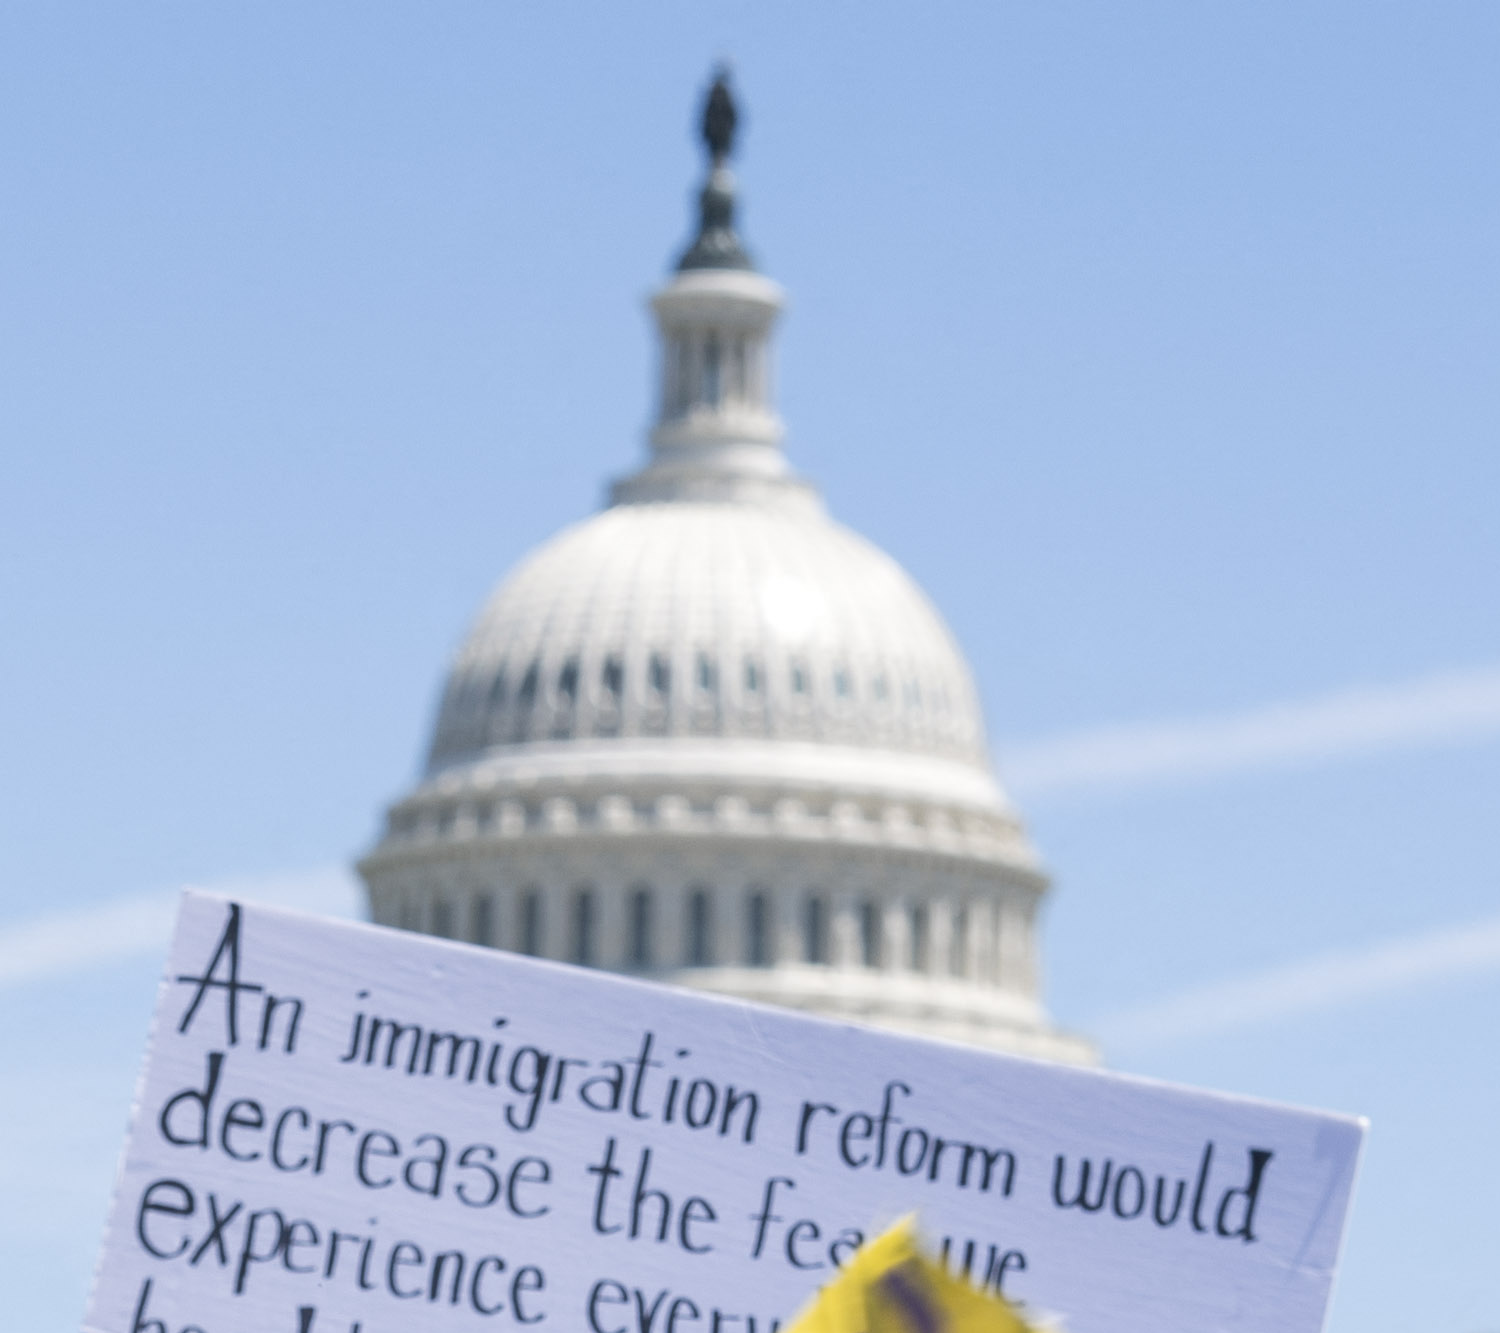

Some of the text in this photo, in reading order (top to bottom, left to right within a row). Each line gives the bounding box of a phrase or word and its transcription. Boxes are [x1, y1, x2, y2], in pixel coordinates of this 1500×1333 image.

[159, 1052, 553, 1217] decrease
[587, 1137, 718, 1254] the
[750, 1177, 866, 1272] fea
[175, 902, 1274, 1244] An immigration reform would
[136, 1177, 548, 1324] experience
